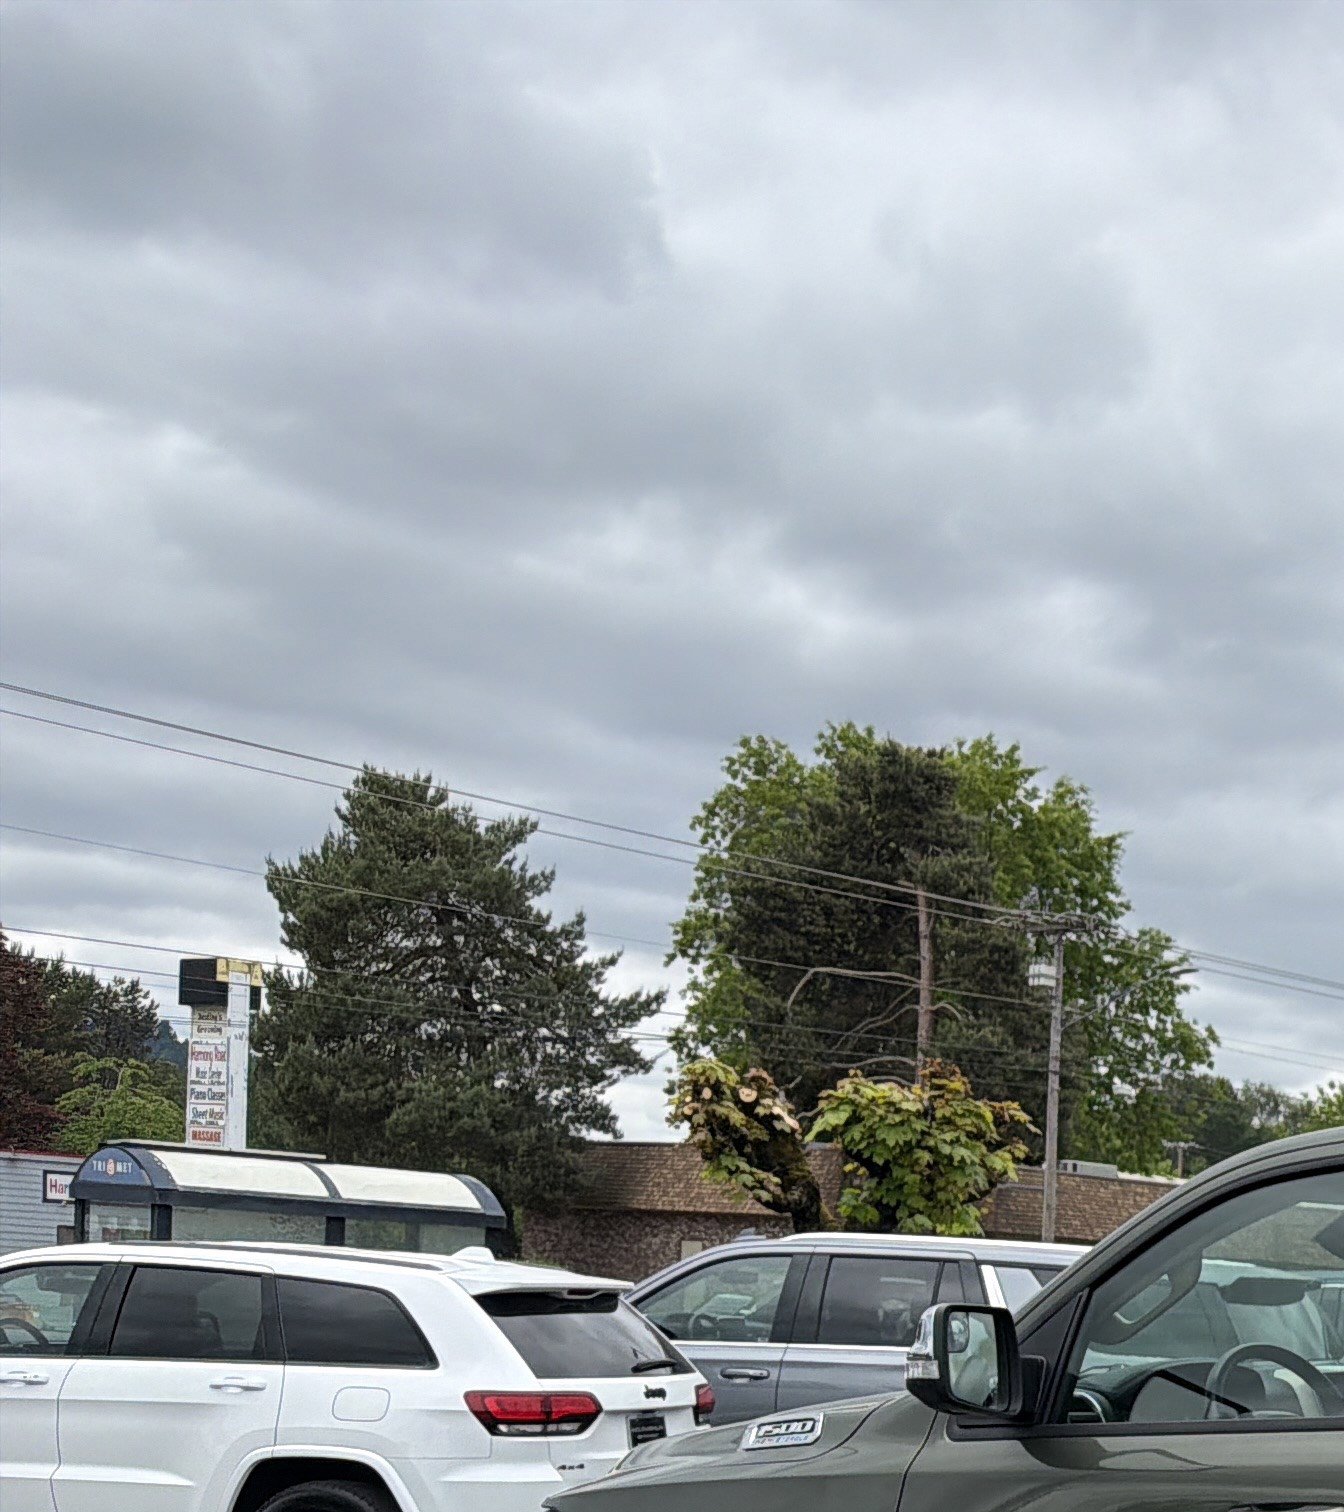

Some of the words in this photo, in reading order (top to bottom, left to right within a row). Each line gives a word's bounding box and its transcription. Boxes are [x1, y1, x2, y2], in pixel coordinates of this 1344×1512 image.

[191, 1107, 207, 1119] Sheet
[191, 1130, 222, 1143] MASSAGE
[93, 1161, 106, 1172] TRI
